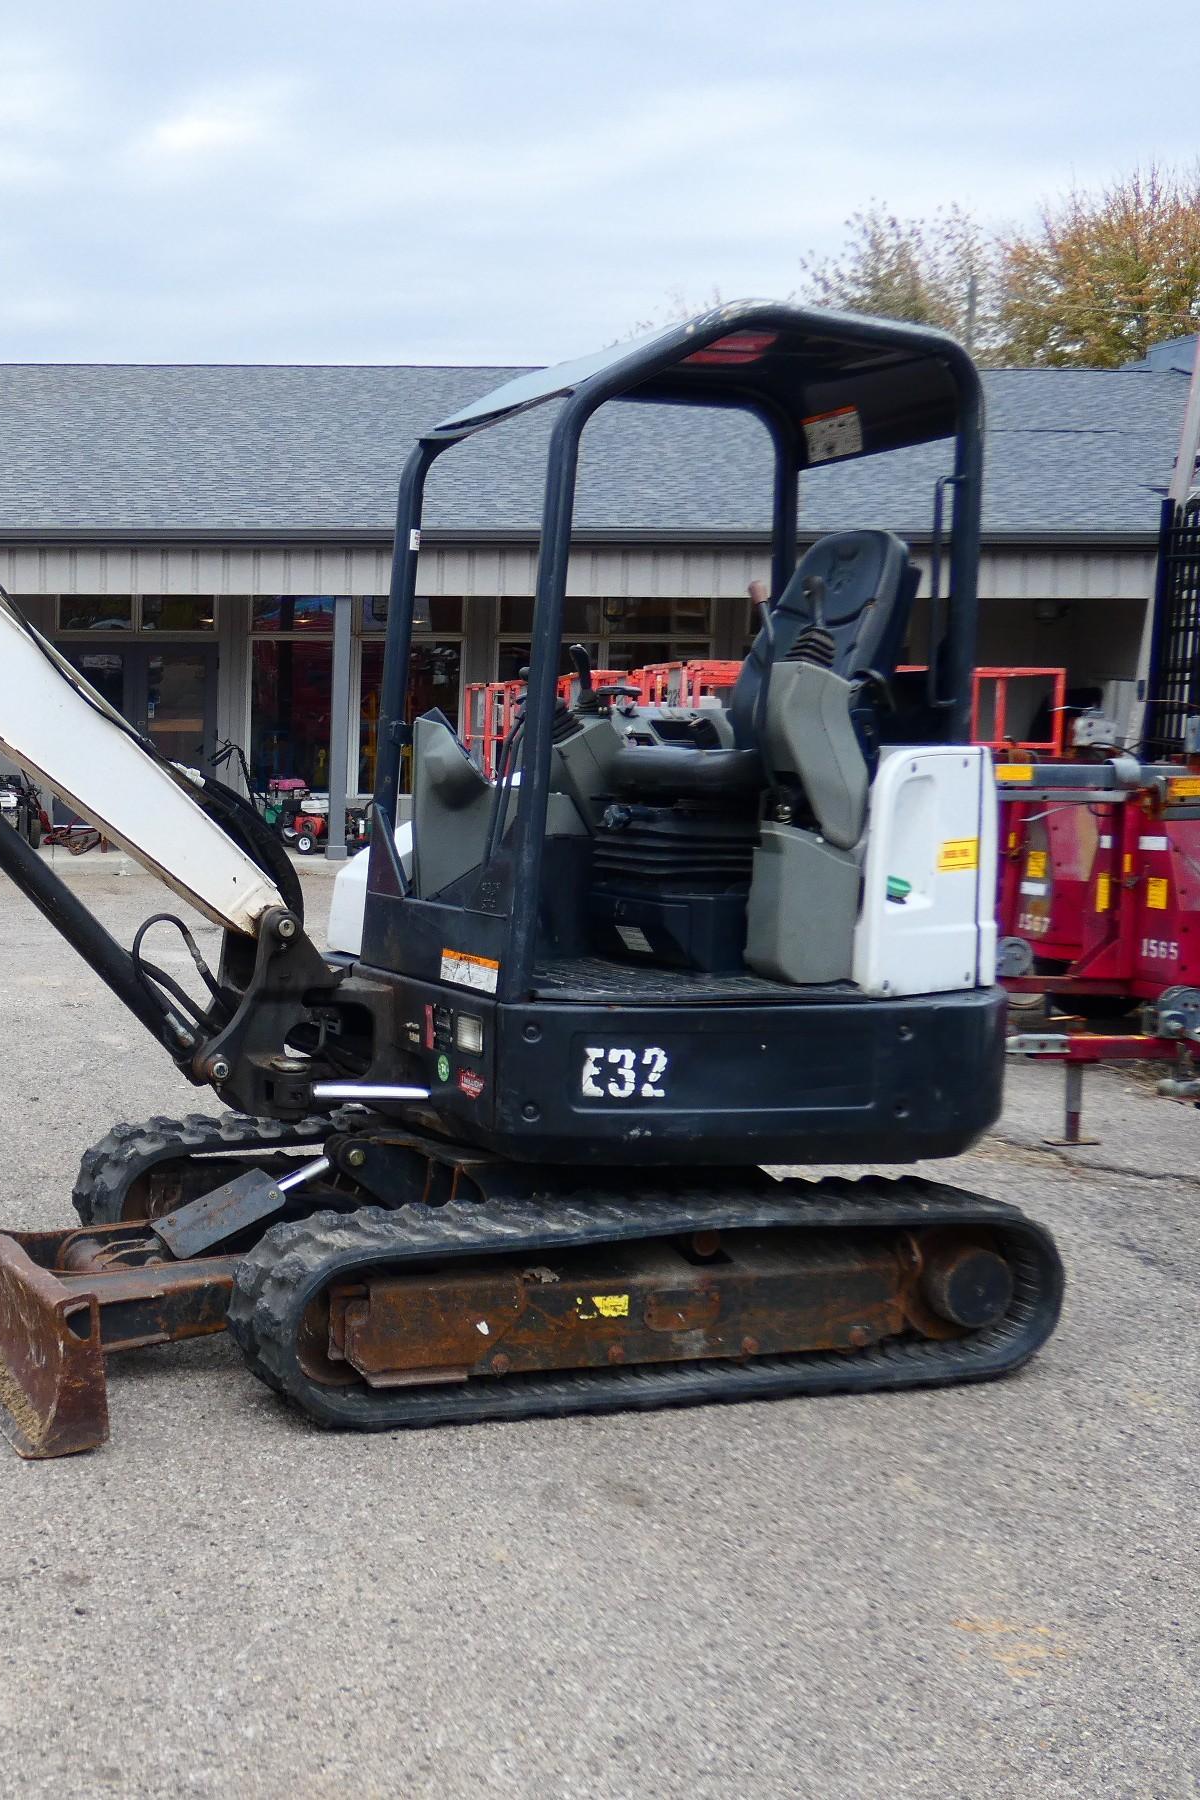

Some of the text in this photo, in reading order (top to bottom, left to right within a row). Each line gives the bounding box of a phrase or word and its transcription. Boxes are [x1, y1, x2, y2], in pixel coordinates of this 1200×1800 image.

[1018, 913, 1051, 933] 1567
[1141, 938, 1179, 960] 1565
[582, 1047, 668, 1098] E32
